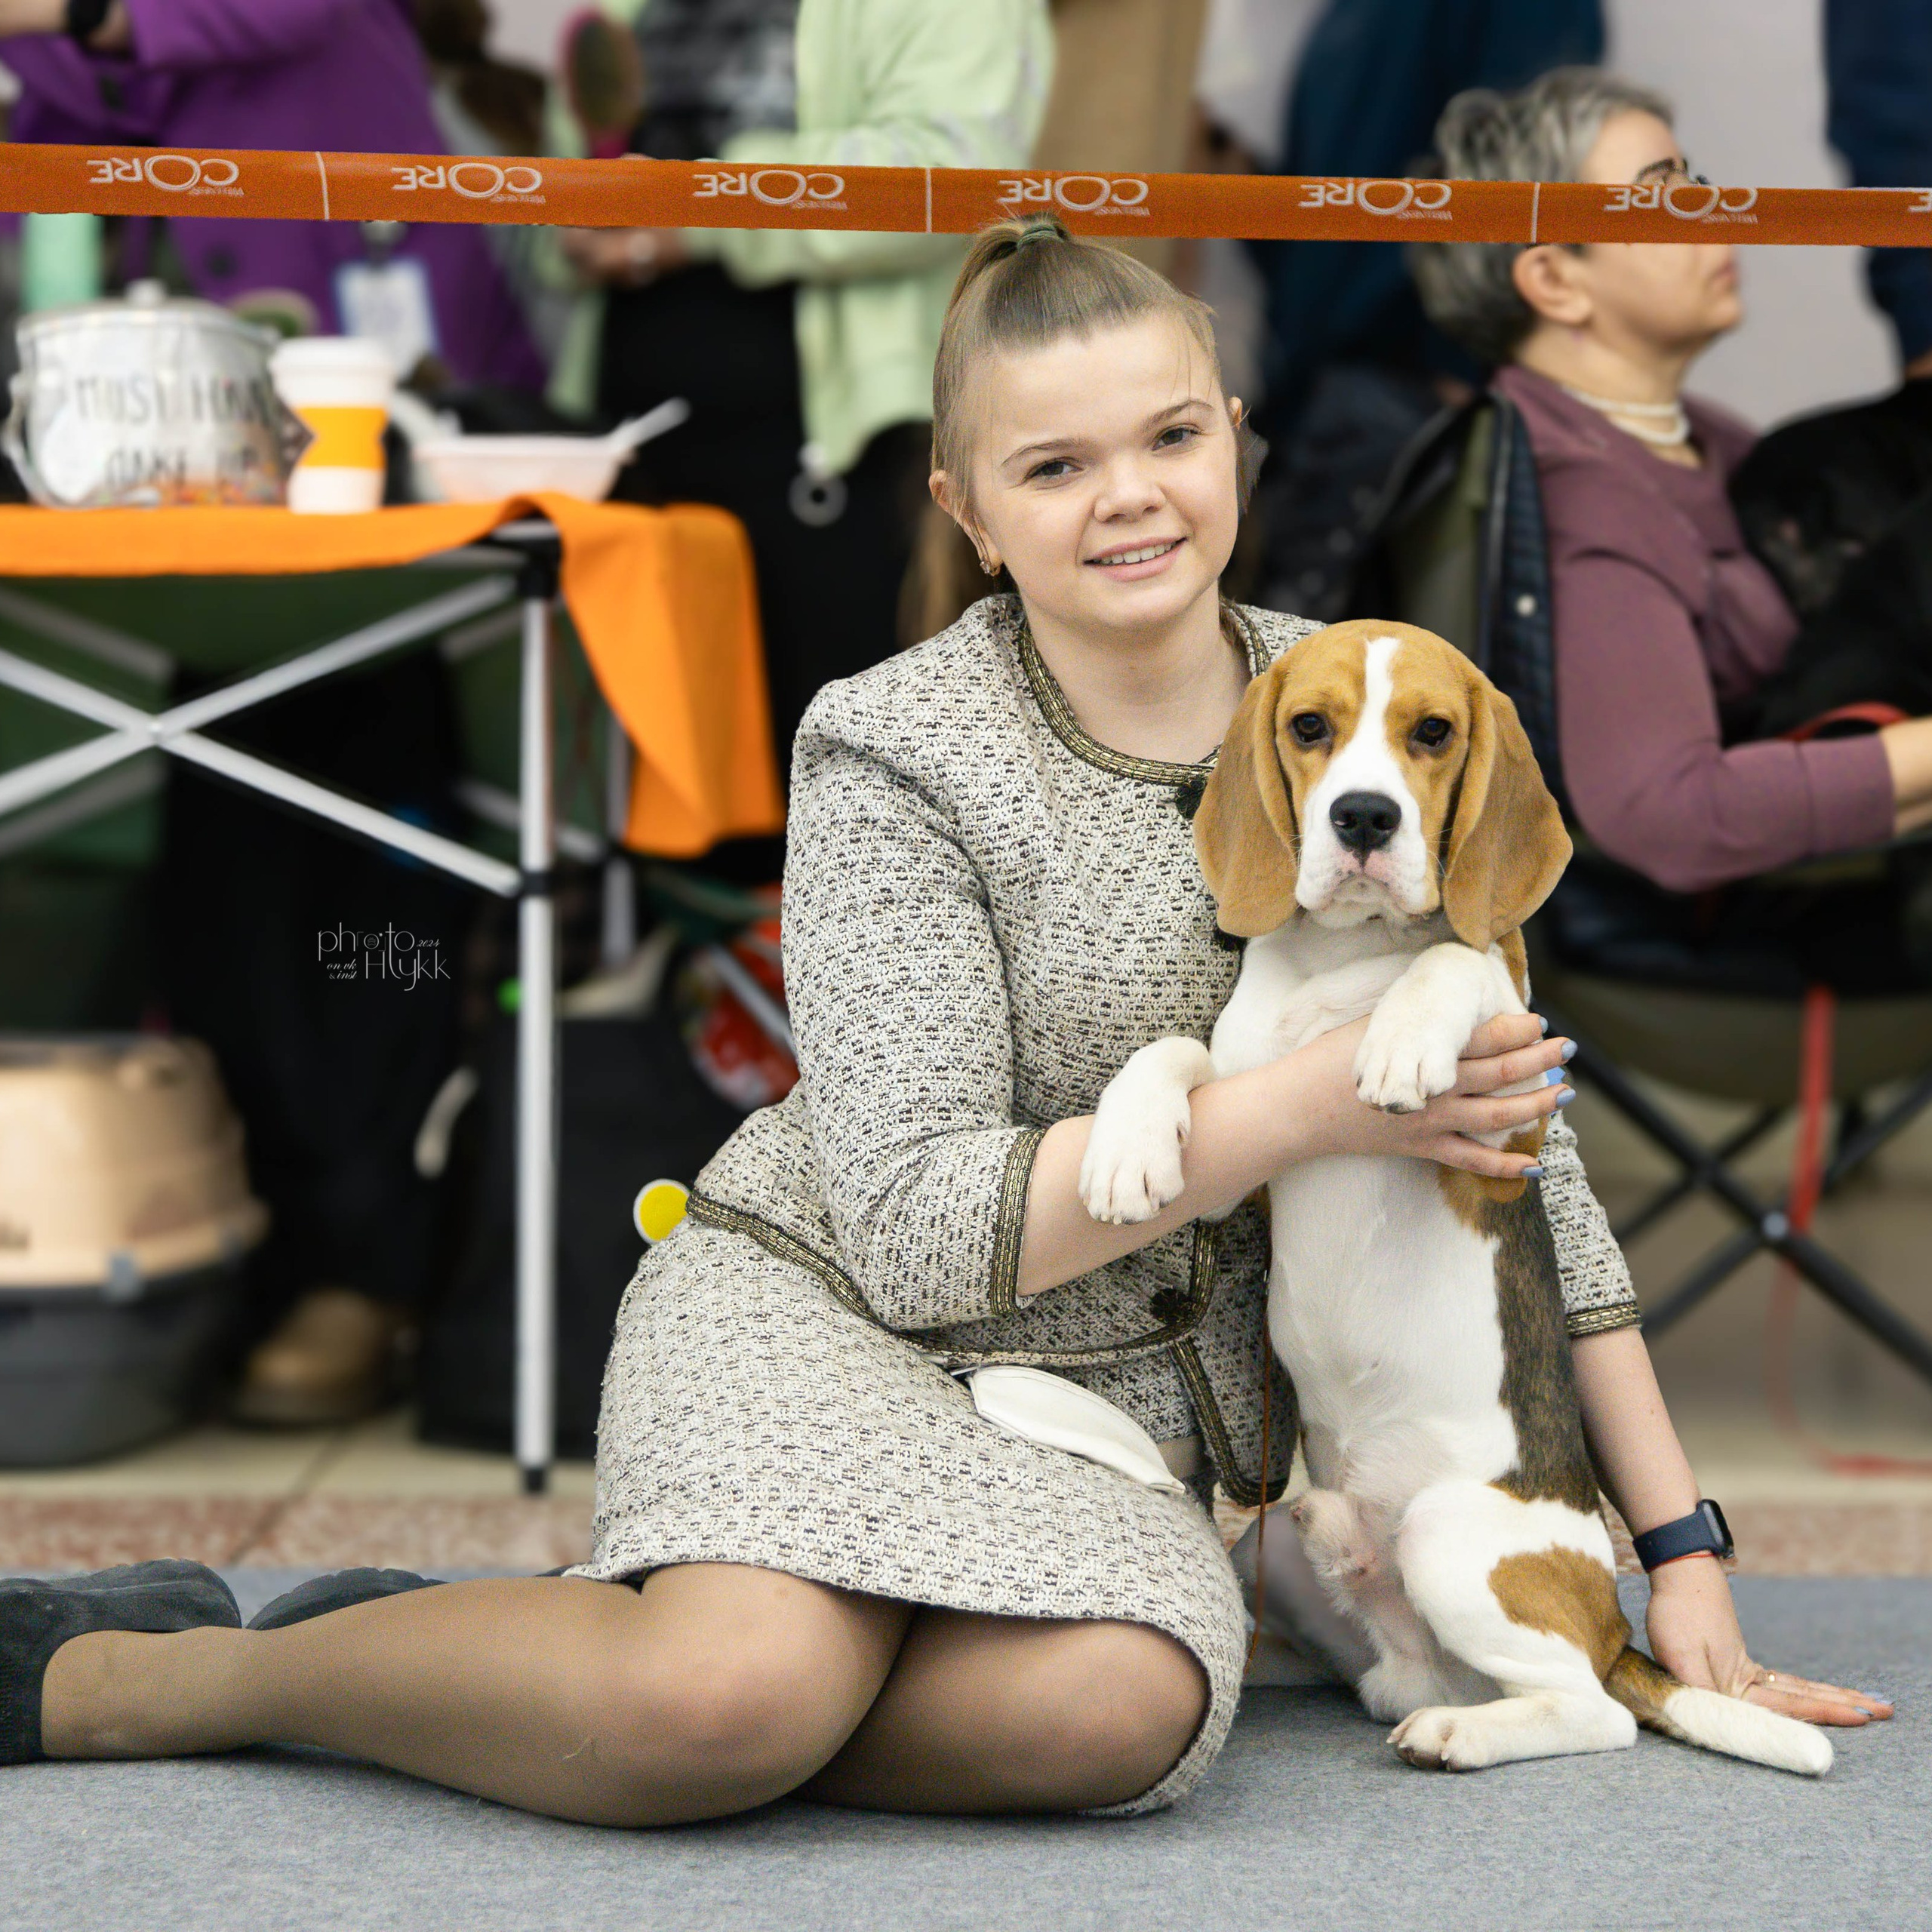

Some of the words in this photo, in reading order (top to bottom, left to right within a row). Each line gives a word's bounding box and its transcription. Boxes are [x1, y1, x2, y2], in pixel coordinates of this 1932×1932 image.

[87, 155, 239, 191] CORE
[391, 162, 543, 198] CORE
[692, 170, 844, 205] CORE
[997, 176, 1149, 211] CORE
[1298, 180, 1452, 215] CORE
[1604, 184, 1758, 219] CORE
